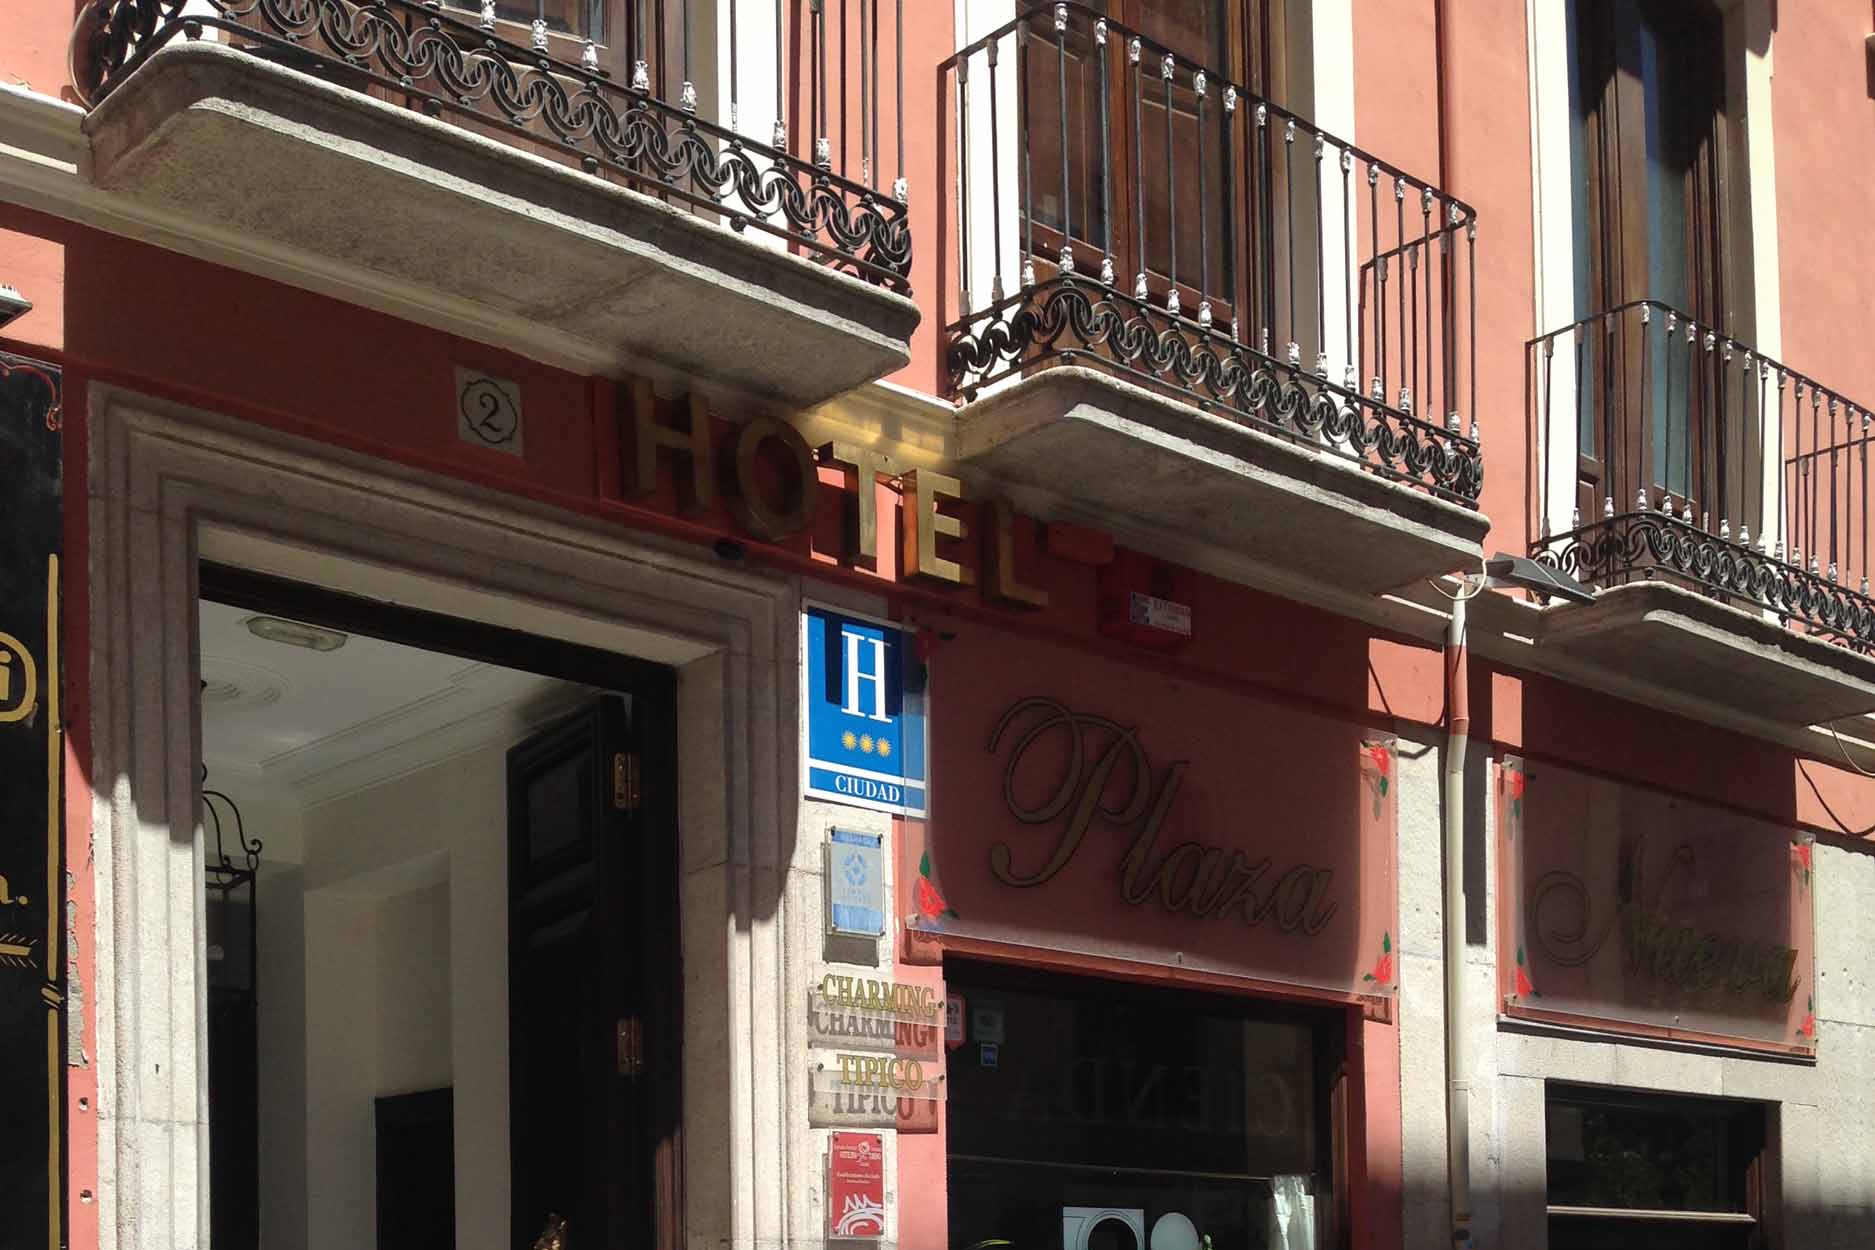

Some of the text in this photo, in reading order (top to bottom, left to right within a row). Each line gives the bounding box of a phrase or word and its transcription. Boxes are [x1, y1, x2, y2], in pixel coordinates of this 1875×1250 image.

[480, 392, 505, 432] 2
[627, 376, 1049, 608] HOTEL
[841, 630, 893, 724] H
[834, 773, 901, 804] CIUDAD
[984, 694, 1338, 938] Plaza
[1529, 834, 1801, 1005] Nueva
[821, 972, 938, 1019] CHARMING
[837, 1053, 924, 1091] TIPICO
